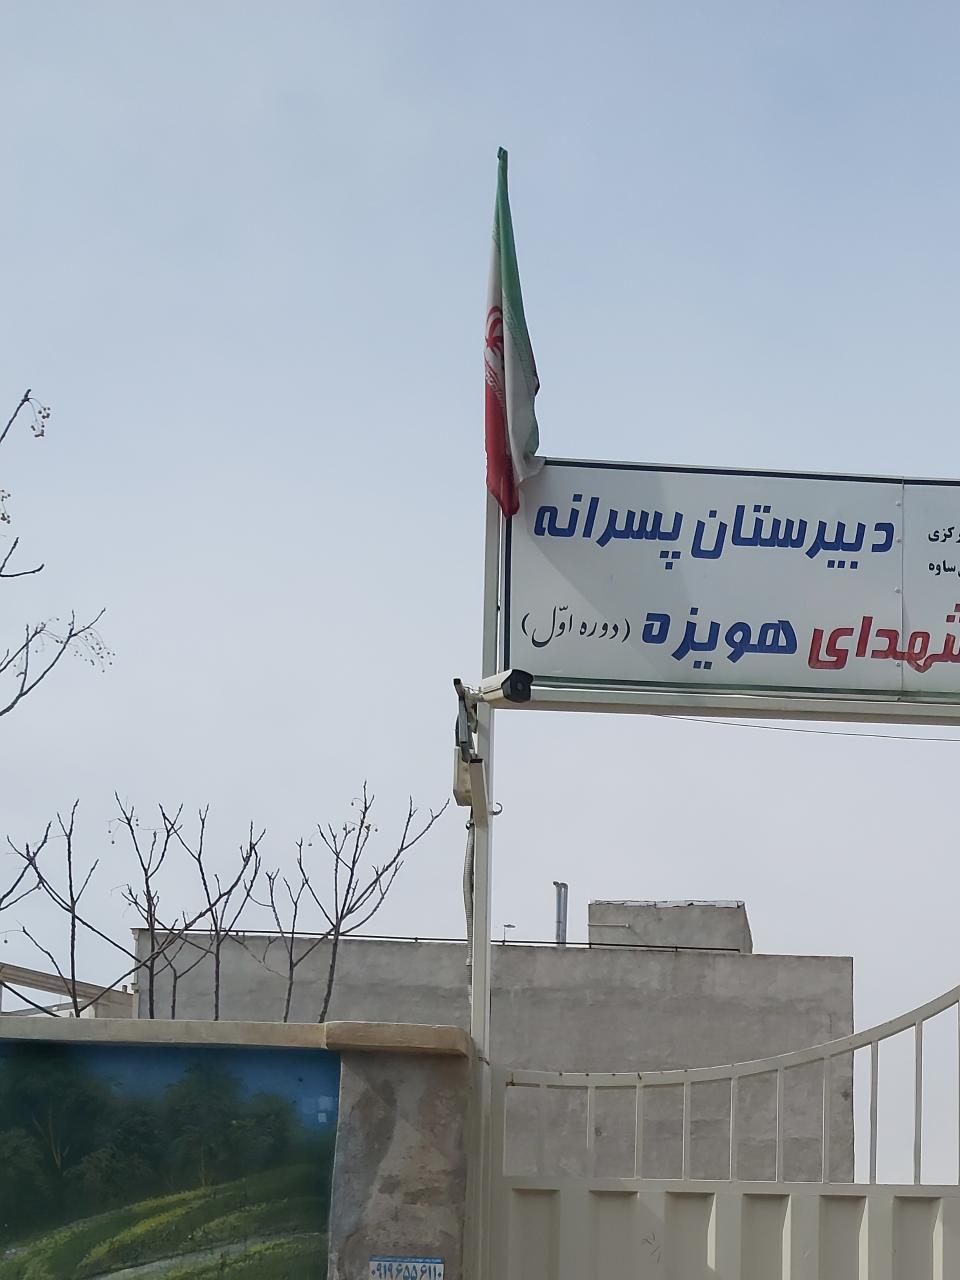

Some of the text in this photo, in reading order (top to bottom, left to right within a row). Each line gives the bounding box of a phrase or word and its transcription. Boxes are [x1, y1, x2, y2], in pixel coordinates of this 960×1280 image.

[533, 492, 895, 570] دبیرستان پسرانه
[928, 559, 956, 577] ساوه
[577, 616, 631, 643] (دوره
[641, 606, 799, 671] هویزه
